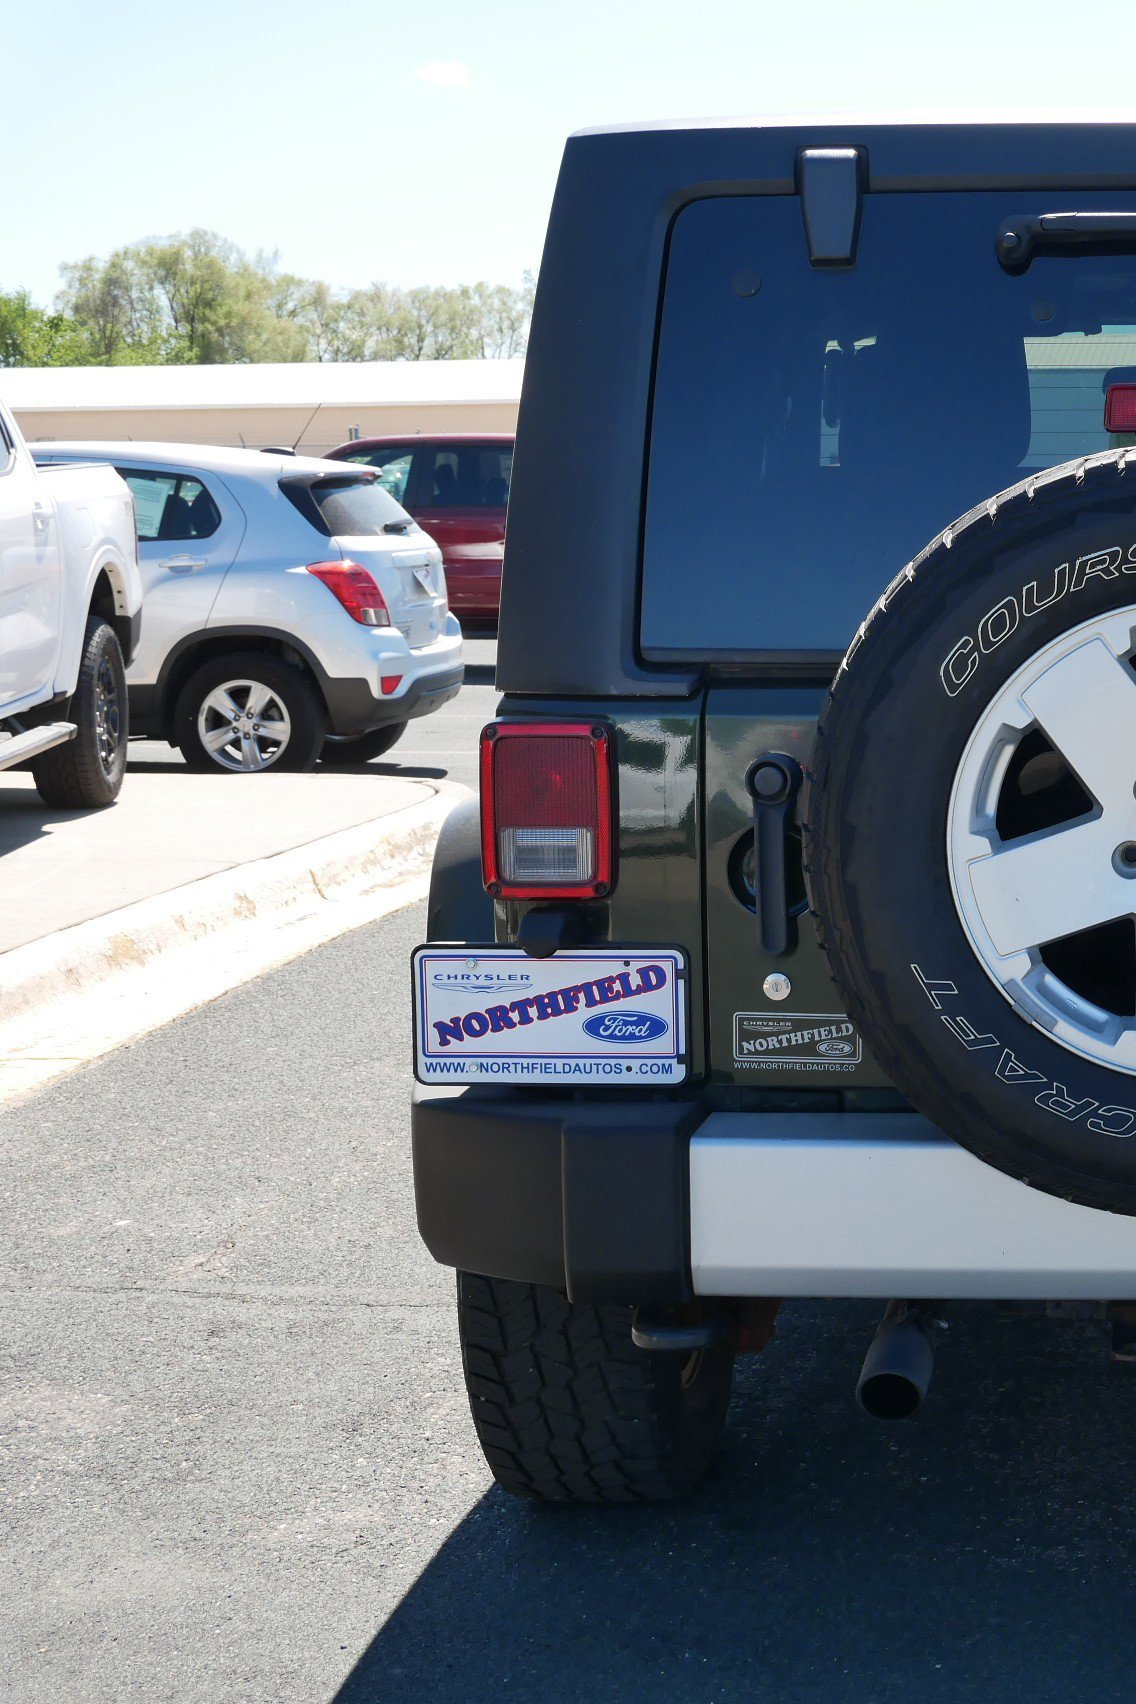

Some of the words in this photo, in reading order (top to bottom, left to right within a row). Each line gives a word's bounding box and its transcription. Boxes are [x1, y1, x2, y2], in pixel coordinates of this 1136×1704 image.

[433, 973, 531, 981] CHRYSLER
[432, 964, 668, 1047] NORTHFIELD
[599, 1014, 651, 1037] Ford
[741, 1022, 854, 1054] NORTHFIELD
[824, 1043, 847, 1053] Ford
